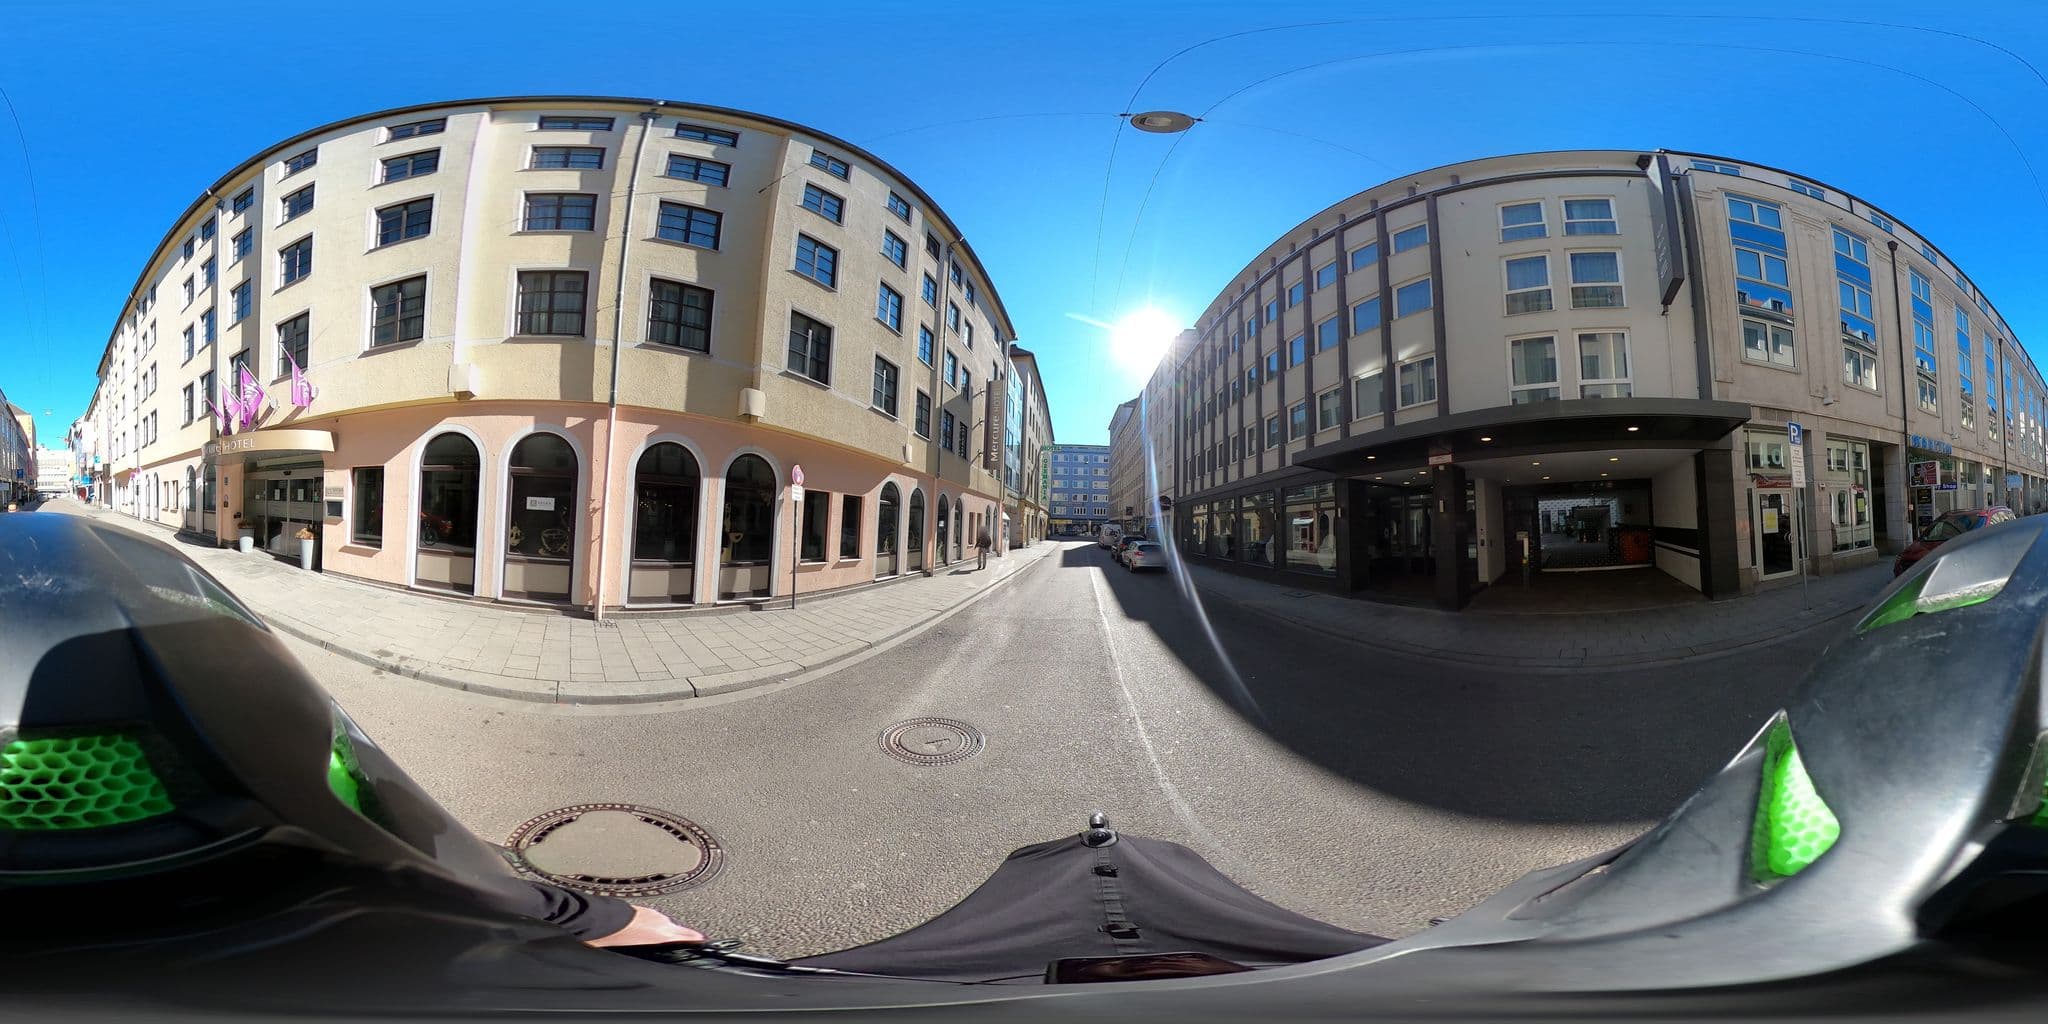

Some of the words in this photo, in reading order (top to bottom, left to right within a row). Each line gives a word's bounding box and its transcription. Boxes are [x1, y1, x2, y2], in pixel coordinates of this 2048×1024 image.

[990, 415, 1000, 463] Mercure
[1790, 425, 1798, 442] P
[223, 438, 255, 451] HOTEL
